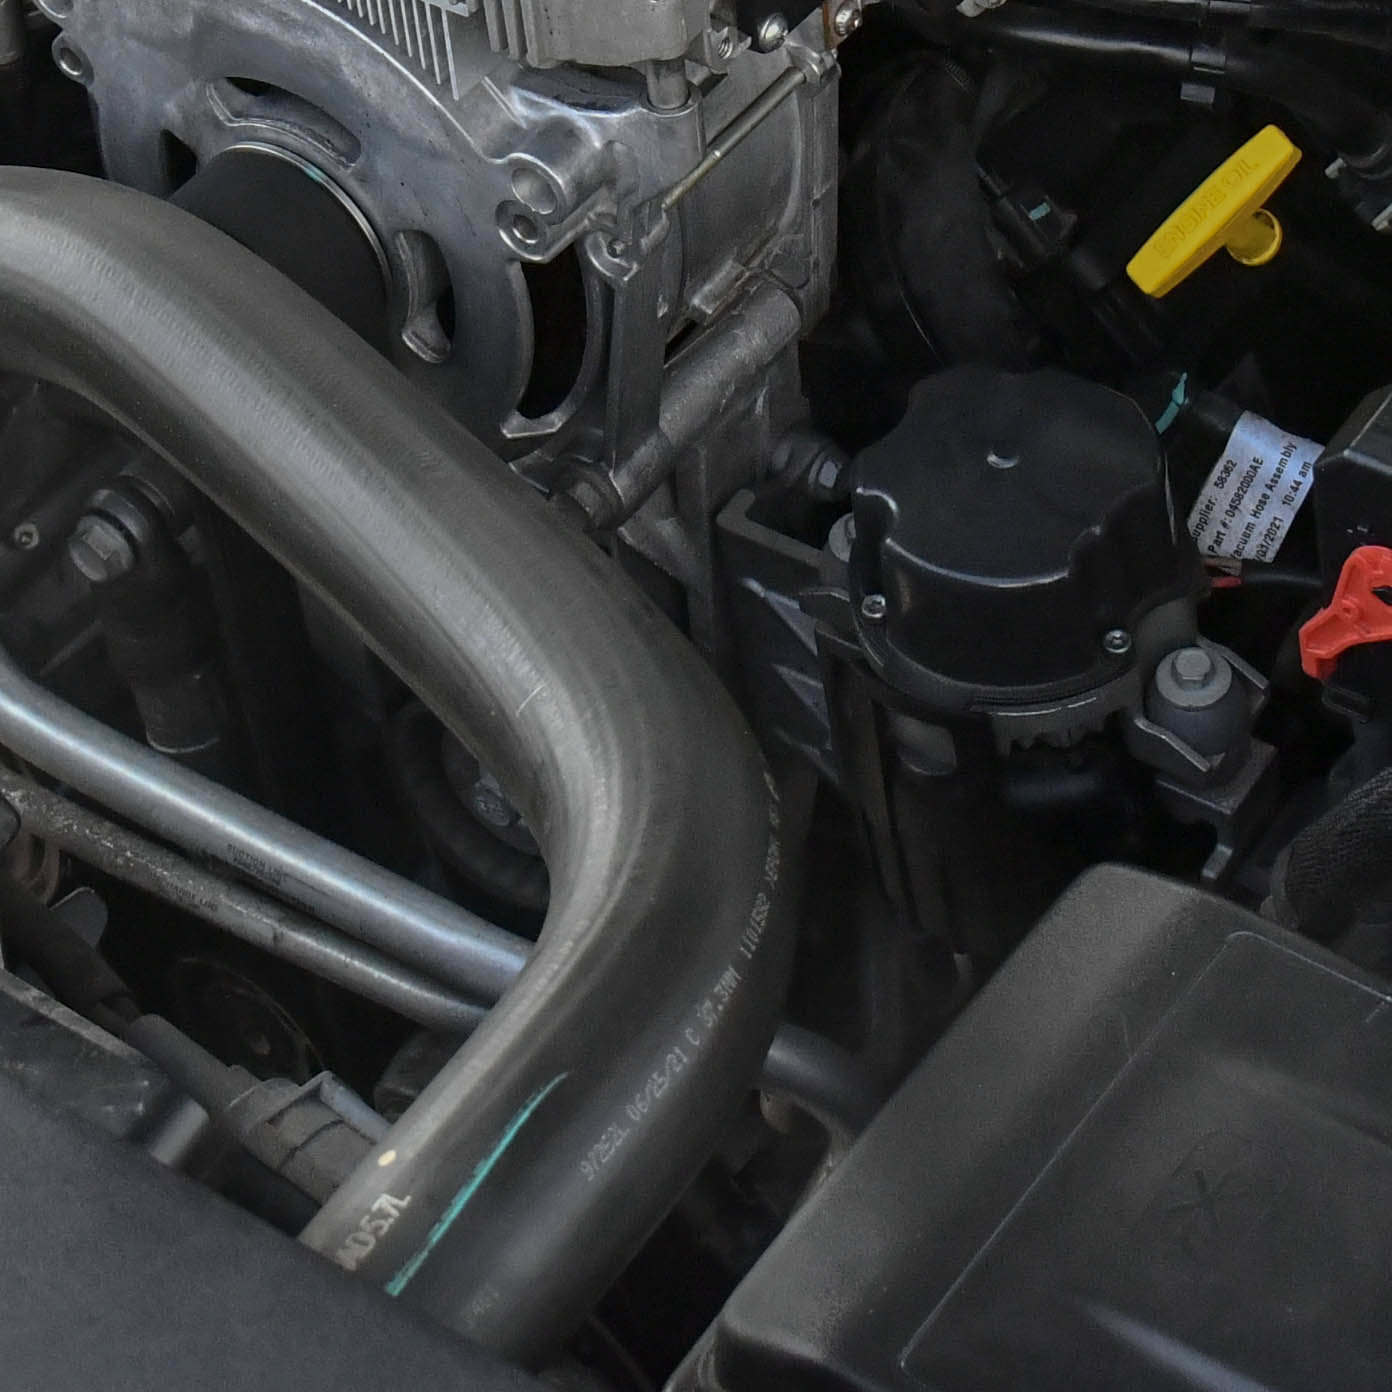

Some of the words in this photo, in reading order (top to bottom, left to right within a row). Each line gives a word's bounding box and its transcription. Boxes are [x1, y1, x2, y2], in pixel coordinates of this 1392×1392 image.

[1250, 494, 1270, 519] Hose
[1268, 441, 1298, 492] Assembly
[1282, 479, 1303, 507] 10:44
[1300, 461, 1312, 478] am
[1208, 532, 1226, 554] Part
